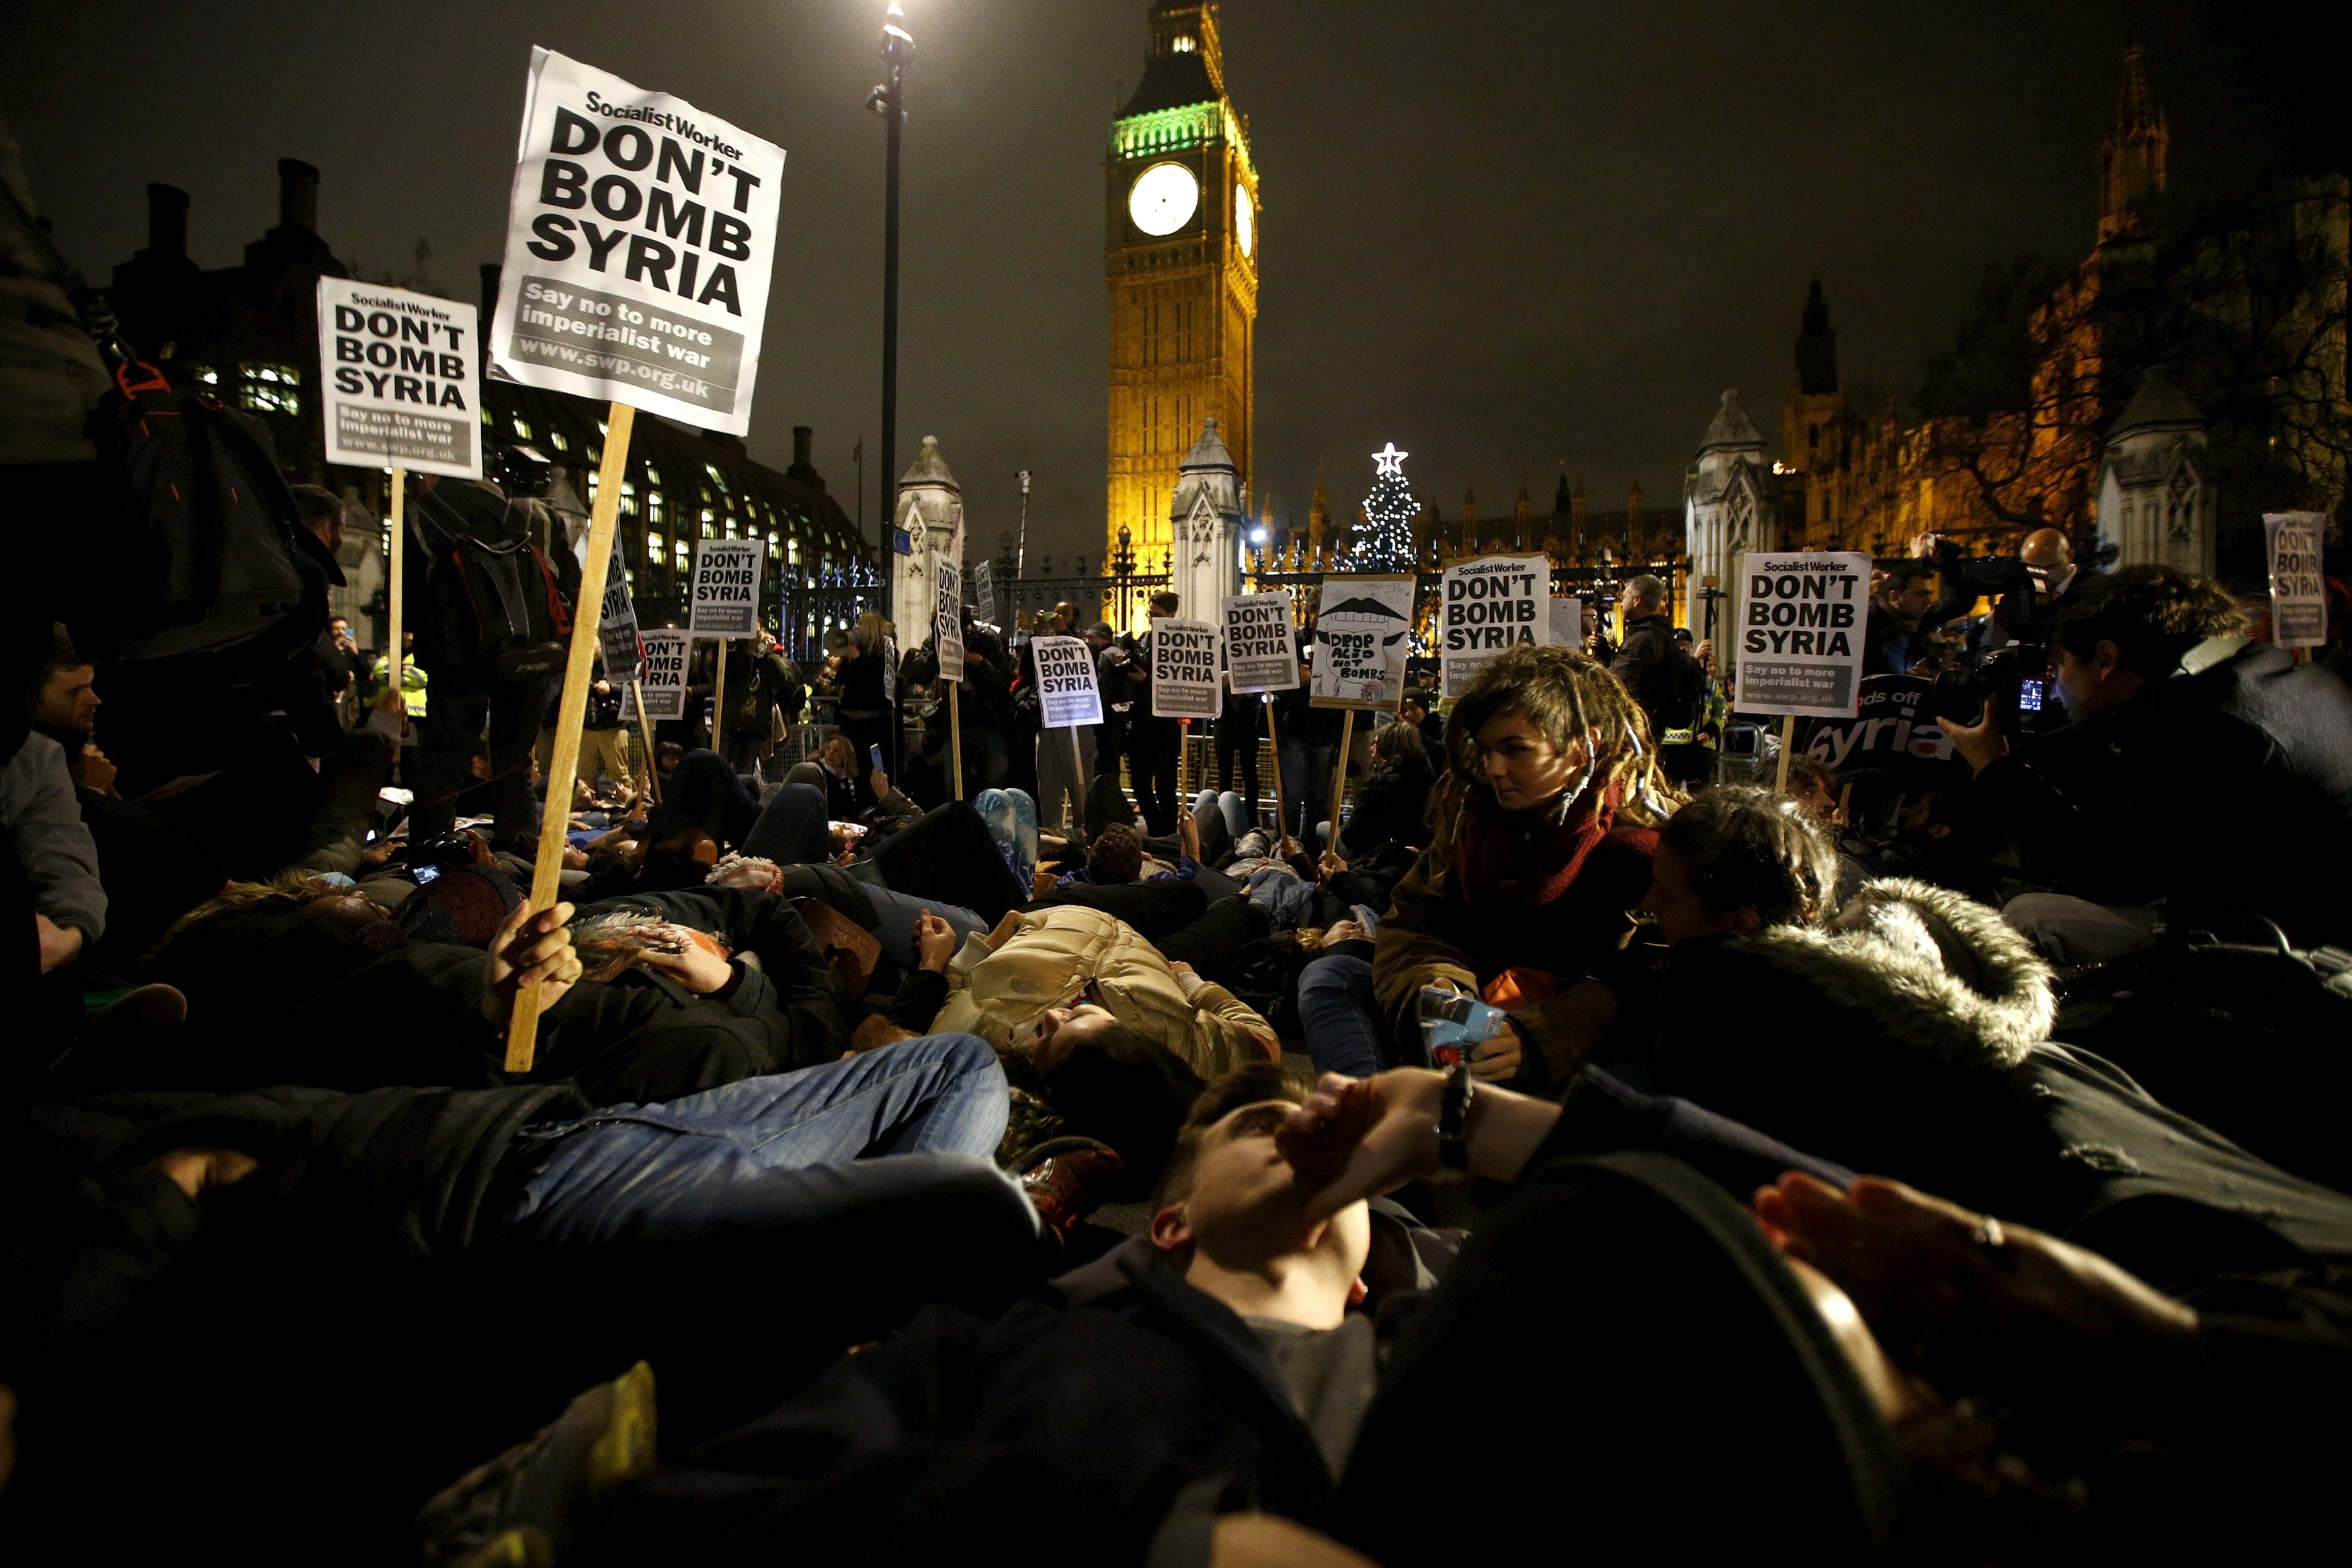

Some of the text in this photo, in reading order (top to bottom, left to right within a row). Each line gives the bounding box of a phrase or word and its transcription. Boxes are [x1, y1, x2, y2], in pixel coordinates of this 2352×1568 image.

[586, 91, 743, 161] Socialist Worker
[550, 105, 761, 214] DON'T
[540, 159, 751, 261] BOMB
[526, 213, 742, 316] SYRIA
[525, 283, 712, 346] Say no to more
[335, 305, 464, 353] DON'T
[522, 304, 710, 369] imperialist war
[335, 336, 465, 380] BOMB
[519, 337, 709, 398] www.swp.org.uk
[335, 367, 466, 412] SYRIA
[339, 406, 452, 432] Say no to more
[340, 419, 452, 445] imperialist war
[701, 554, 756, 568] DON'T
[1458, 563, 1526, 576] Socialist Worker
[1764, 562, 1848, 572] Socialist Worker
[699, 570, 753, 584] BOMB
[696, 585, 751, 601] SYRIA
[1448, 574, 1536, 601] DON'T
[1751, 574, 1859, 600] DON'T
[1228, 607, 1285, 625] DON'T
[1447, 599, 1536, 625] BOMB
[1749, 602, 1855, 627] BOMB
[1158, 631, 1215, 650] DON'T
[1229, 623, 1287, 641] BOMB
[1331, 634, 1374, 648] DROP
[1447, 625, 1536, 650] SYRIA
[645, 642, 685, 655] ON'T
[1230, 639, 1289, 658] SYRIA
[1745, 629, 1851, 656] SYRIA
[1038, 647, 1085, 662] DON'T
[1157, 648, 1215, 666] BOMB
[1331, 648, 1374, 659] ACID
[647, 658, 683, 670] OMB
[1041, 662, 1090, 677] BOMB
[1234, 668, 1269, 677] imperialist
[1333, 659, 1363, 668] NOT
[1449, 662, 1467, 670] Say
[1746, 665, 1835, 677] Say no to more
[1157, 664, 1215, 683] SYRIA
[1340, 667, 1386, 681] BOMBS
[1746, 676, 1835, 689] imperialist war
[1044, 677, 1093, 693] SYRIA
[1158, 687, 1170, 695] Say
[1157, 693, 1194, 701] imperialist
[1892, 691, 1922, 705] off
